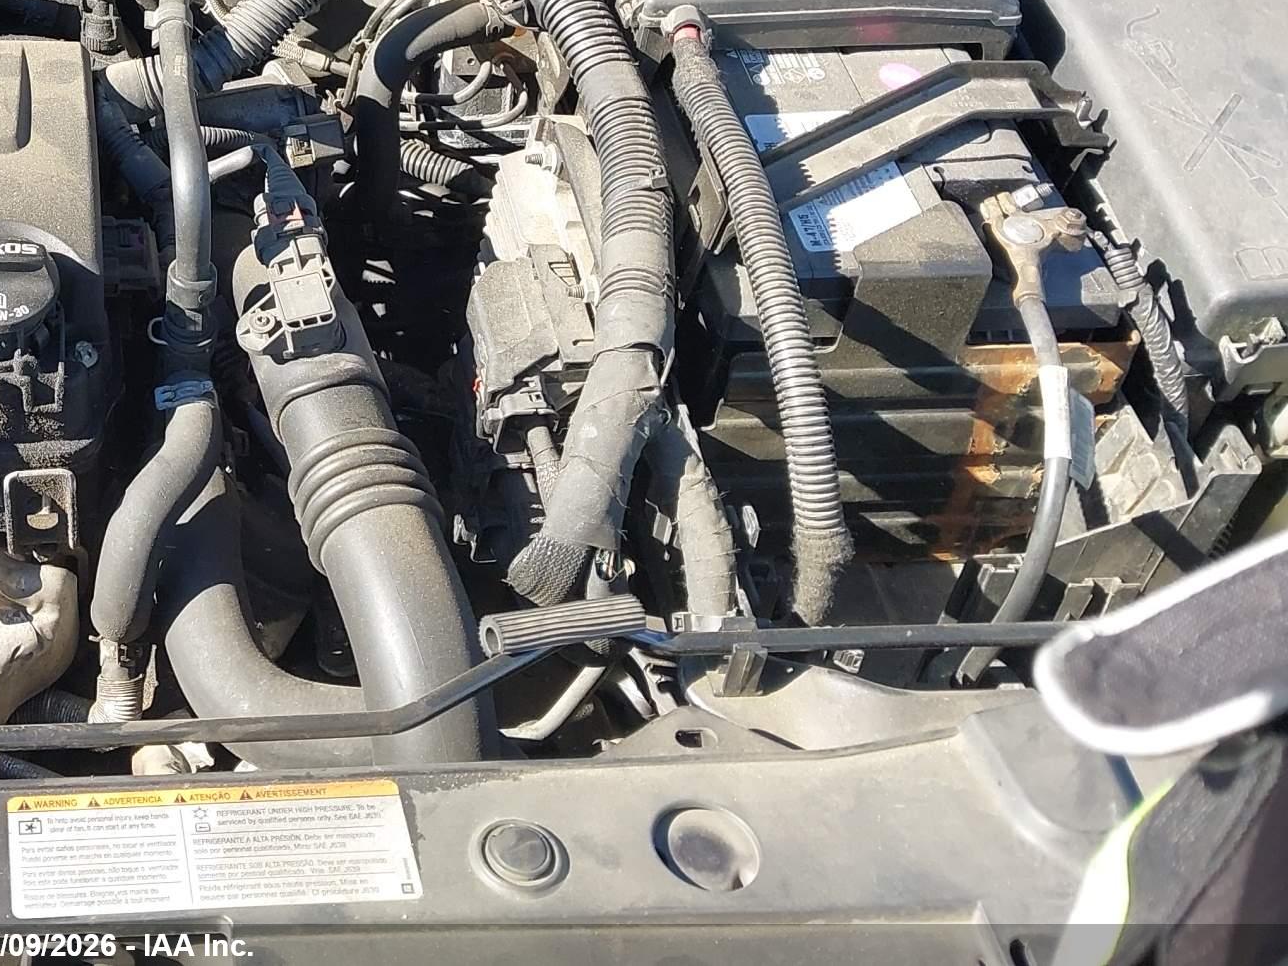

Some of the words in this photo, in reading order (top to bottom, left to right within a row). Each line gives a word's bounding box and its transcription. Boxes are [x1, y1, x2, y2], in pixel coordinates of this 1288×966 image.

[34, 799, 78, 809] WARNING
[103, 796, 163, 806] ADVERTENCIA
[189, 792, 231, 802] ATENÇÃO
[255, 788, 327, 798] AVERTISSEMENT
[88, 815, 113, 824] personal
[134, 814, 150, 822] keep
[218, 818, 246, 826] serviced
[248, 818, 256, 826] by
[128, 822, 140, 830] any
